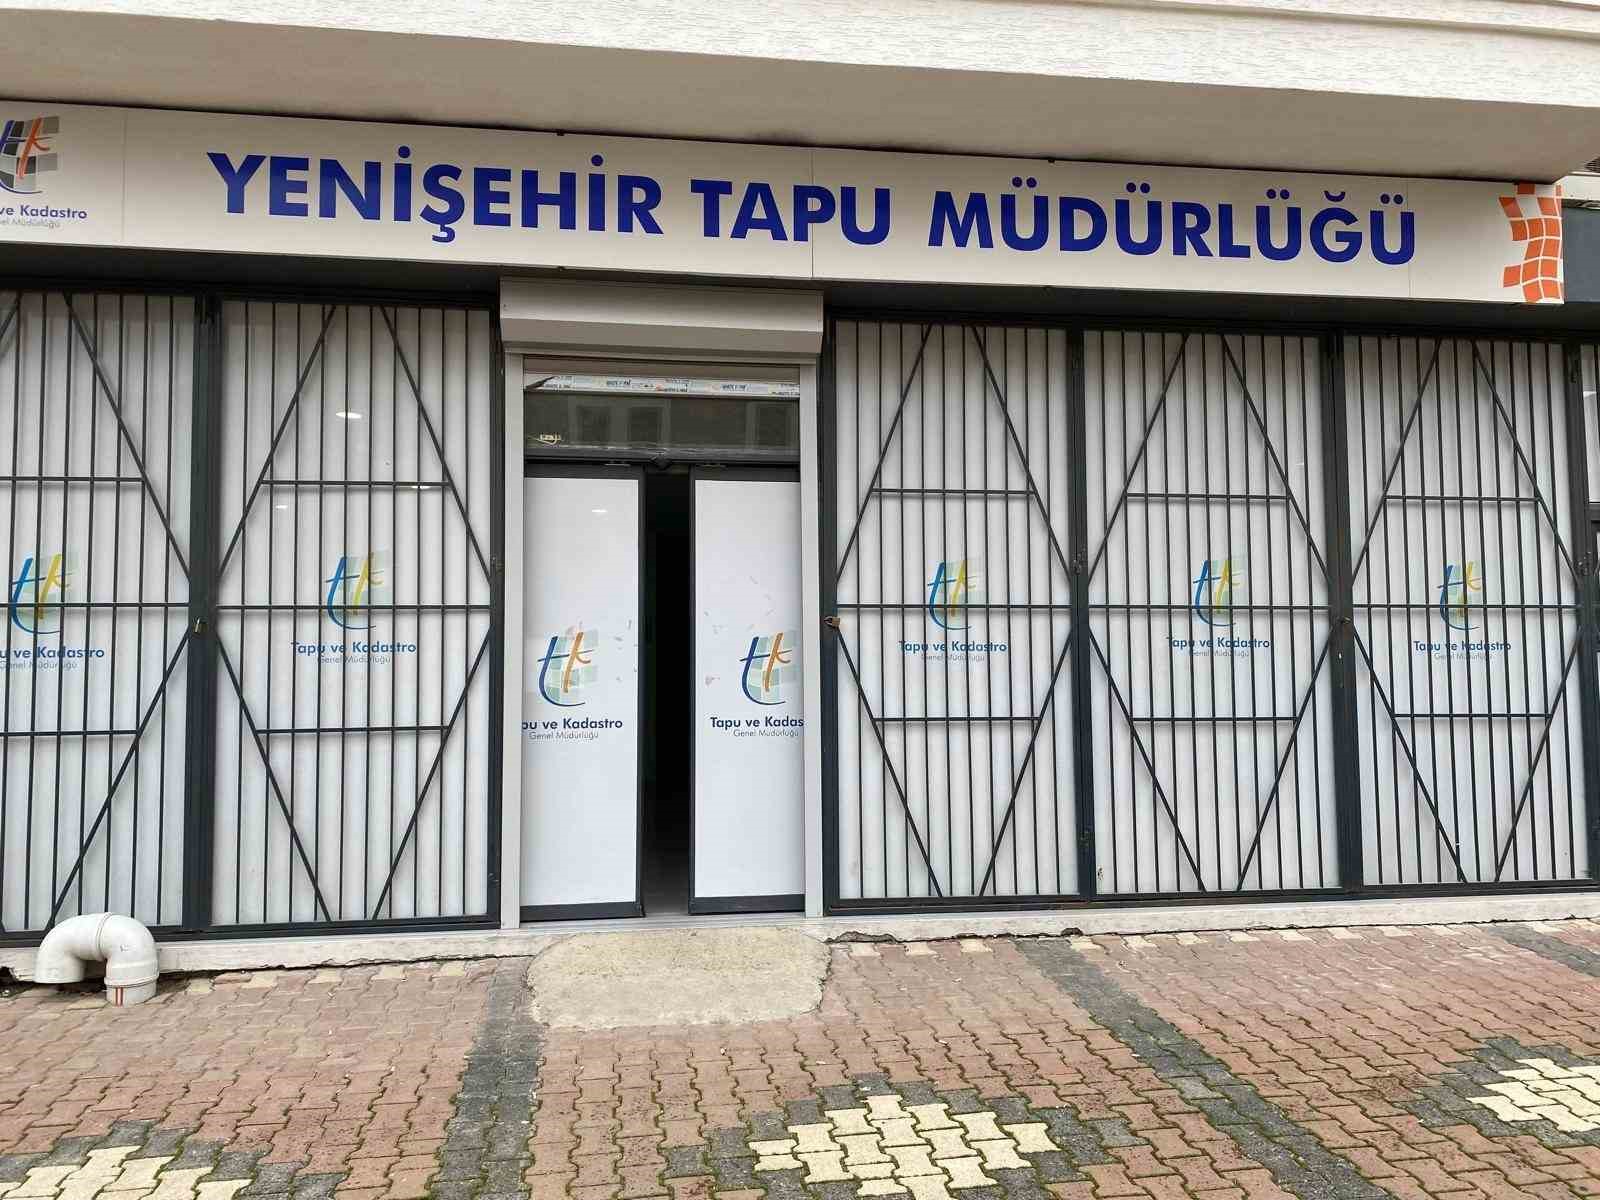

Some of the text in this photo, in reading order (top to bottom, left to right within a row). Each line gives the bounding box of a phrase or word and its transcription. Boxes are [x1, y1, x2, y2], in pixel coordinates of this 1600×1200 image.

[206, 145, 1416, 266] YENİŞEHİR TAPU MÜDÜRLÜĞÜ
[20, 203, 88, 220] Kadastro
[331, 644, 346, 653] ve
[933, 643, 947, 652] ve
[951, 641, 1008, 652] Kadastro
[1446, 643, 1458, 651] e
[14, 649, 32, 659] ve
[1214, 649, 1250, 658] Müdülüğü
[316, 655, 391, 665] enel Müdülüğü
[30, 660, 78, 671] üdürüğü
[542, 720, 558, 730] ve
[563, 717, 623, 730] Kadastro
[710, 715, 805, 731] Tapu ve Kadas
[733, 729, 755, 738] Genel
